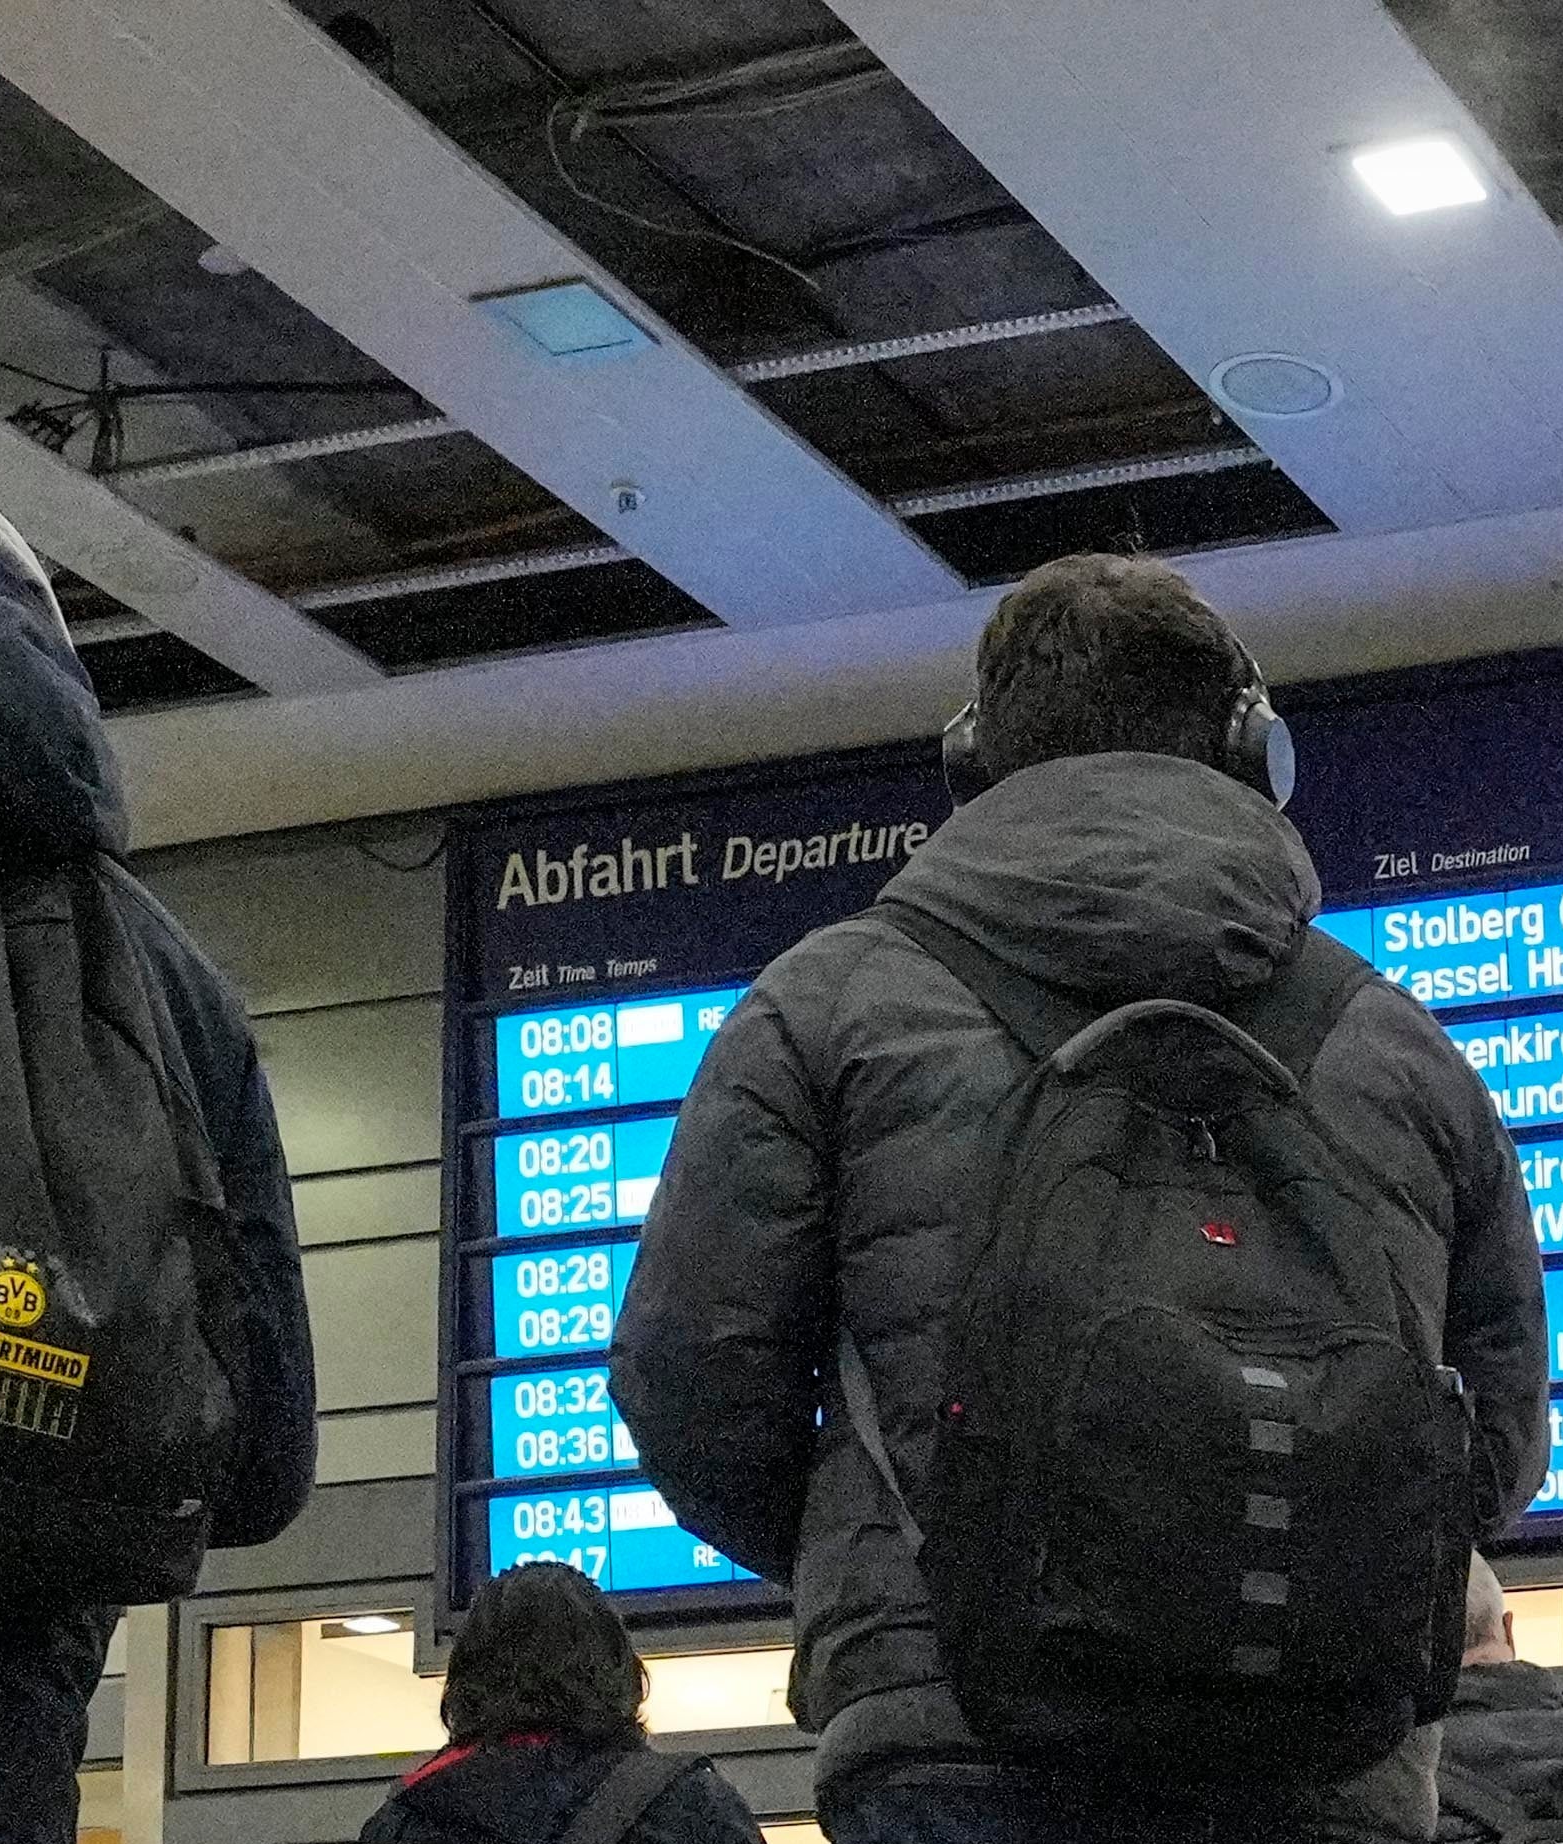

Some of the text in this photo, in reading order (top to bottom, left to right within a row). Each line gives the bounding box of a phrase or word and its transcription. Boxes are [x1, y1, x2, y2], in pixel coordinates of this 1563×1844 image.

[497, 832, 699, 910] Abfahrt
[722, 820, 929, 883] Departure
[1373, 850, 1418, 881] Ziel
[1431, 841, 1530, 872] Destination
[1384, 902, 1544, 952] Stolberg
[509, 963, 548, 990] Zeit
[557, 957, 657, 985] Time Temps
[520, 1012, 613, 1058] 08:08
[522, 1062, 614, 1108] 08:14
[519, 1132, 610, 1178] 08:20
[520, 1182, 612, 1228] 08:25
[516, 1252, 609, 1298] 08:28
[518, 1303, 612, 1348] 08:29
[515, 1374, 608, 1419] 08:32
[516, 1425, 608, 1469] 08:36
[513, 1496, 606, 1541] 08:43
